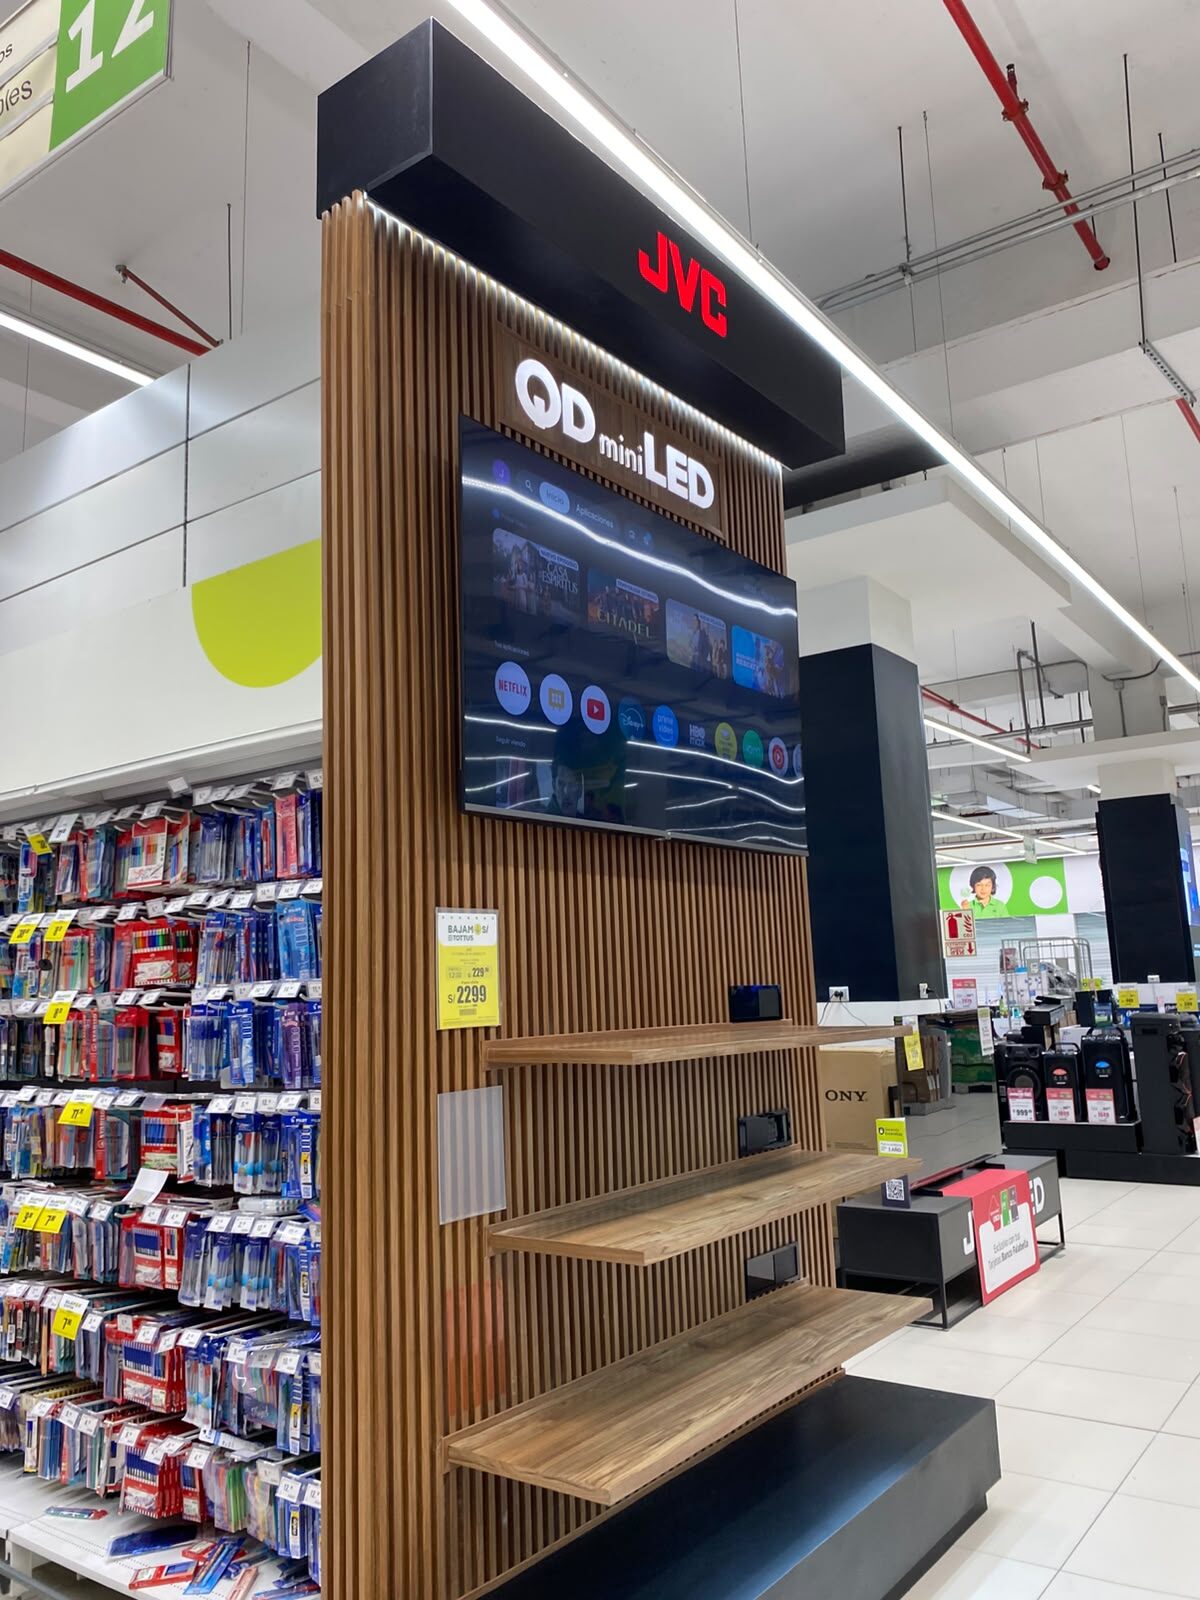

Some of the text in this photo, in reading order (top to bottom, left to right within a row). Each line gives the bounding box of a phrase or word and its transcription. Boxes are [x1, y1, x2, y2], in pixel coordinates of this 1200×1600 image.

[66, 0, 154, 93] 12
[638, 230, 728, 338] JVC
[515, 358, 597, 443] QD
[576, 504, 614, 529] Aplicaciones
[547, 561, 568, 581] CASA
[597, 606, 650, 638] CITADEL
[498, 679, 528, 697] NETFLIX
[689, 723, 705, 739] HBO
[453, 934, 474, 942] TOTTUS
[448, 984, 487, 1005] S/ 2299
